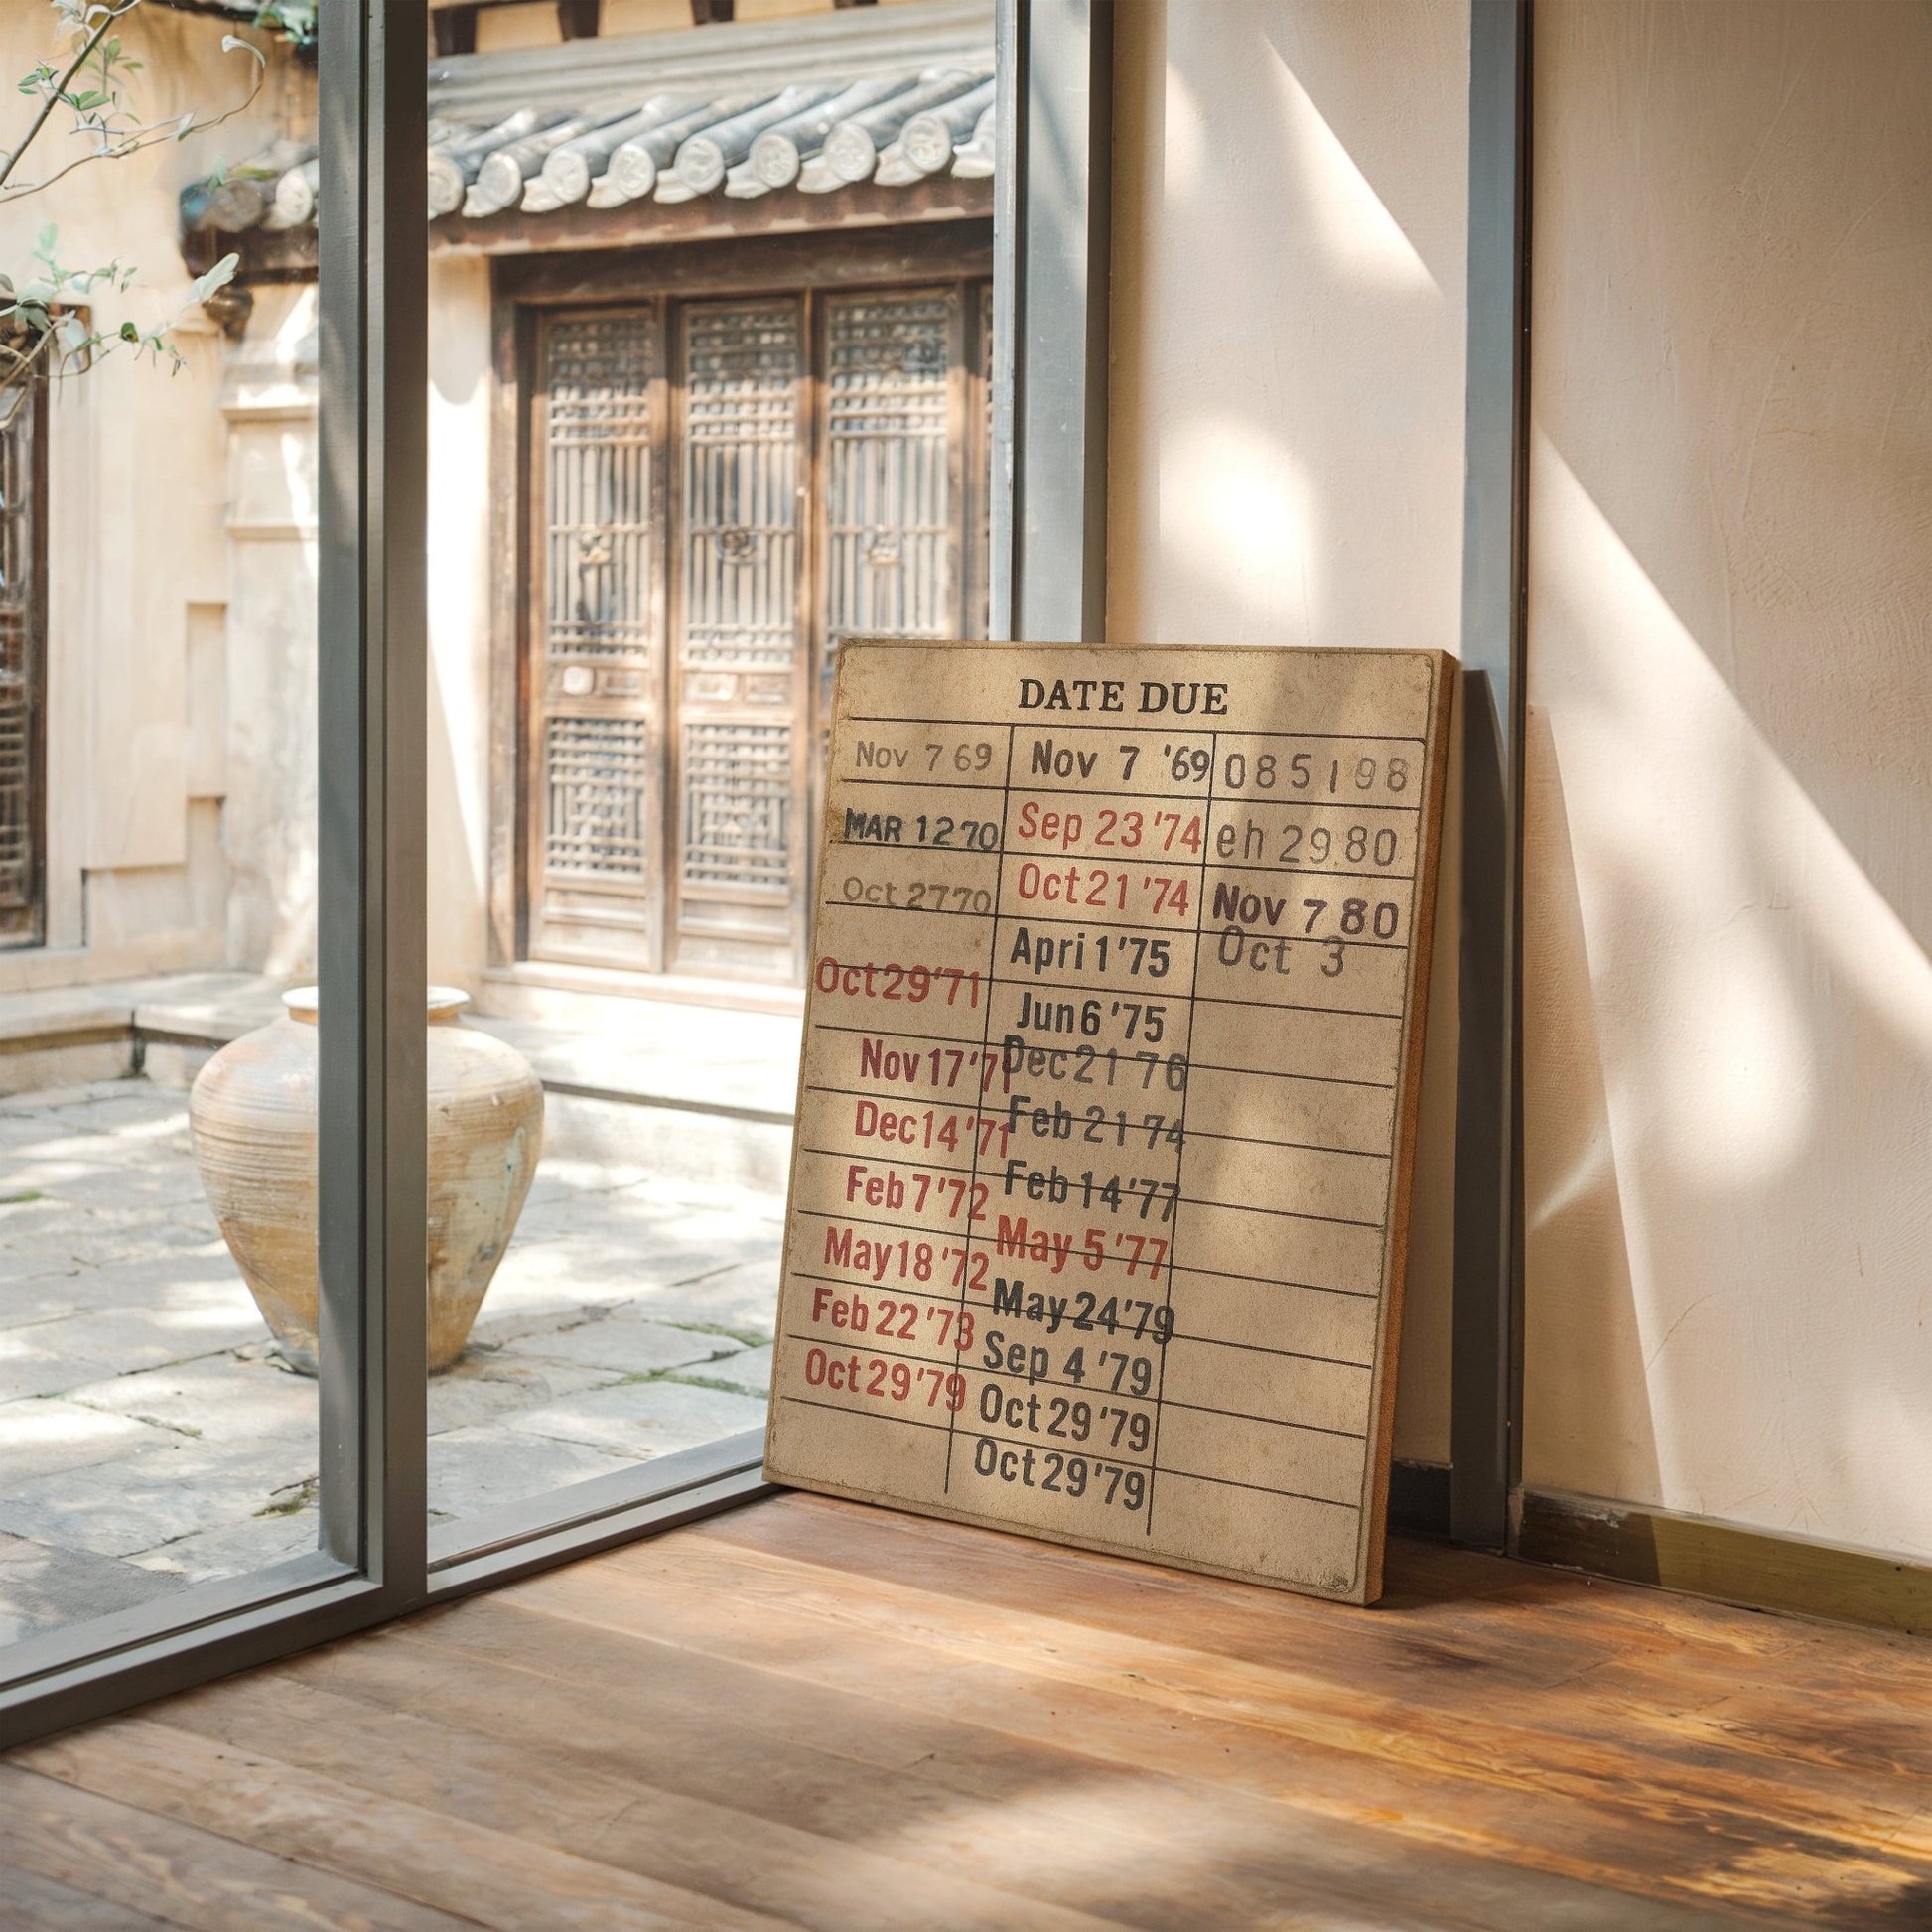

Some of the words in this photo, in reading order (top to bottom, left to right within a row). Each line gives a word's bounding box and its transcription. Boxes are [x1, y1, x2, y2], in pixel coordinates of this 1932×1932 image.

[1018, 678, 1125, 712] DATE
[1138, 681, 1228, 715] DUE
[856, 740, 908, 769] Nov
[925, 744, 943, 771] 7
[954, 743, 993, 771] 69
[1031, 739, 1098, 779] Nov
[1119, 745, 1140, 781] 7
[1163, 743, 1211, 782] '69
[844, 807, 902, 842] MAR
[1018, 801, 1083, 850] Sep
[1094, 809, 1144, 848] 23
[1154, 811, 1202, 854] '74
[843, 876, 897, 907] Oct
[1018, 863, 1081, 904] Oct
[1085, 869, 1128, 910] 21
[1143, 876, 1189, 917] '74
[1212, 882, 1287, 926] Nov
[1218, 924, 1292, 975] Oct
[1320, 935, 1345, 978] 3
[1016, 992, 1074, 1034] Jun
[1111, 1001, 1167, 1043] '75
[860, 1037, 921, 1083] Nov
[928, 1047, 965, 1088] 17
[1002, 1034, 1067, 1080] Dec
[855, 1100, 917, 1145] Dec
[1008, 1095, 1072, 1140] Feb
[1083, 1105, 1126, 1146] 21
[846, 1165, 905, 1210] Feb
[912, 1173, 932, 1213] 7
[1004, 1159, 1068, 1204] Feb
[824, 1225, 893, 1282] May
[996, 1214, 1073, 1274] May
[1083, 1228, 1106, 1271] 5
[1115, 1232, 1169, 1280] '77
[811, 1287, 869, 1332] Feb
[875, 1299, 919, 1341] 22
[993, 1277, 1068, 1334] May
[805, 1348, 861, 1393] Oct
[982, 1330, 1049, 1386] Sep
[1063, 1347, 1086, 1383] 4
[1098, 1350, 1152, 1396] '79
[979, 1383, 1041, 1433] Oct
[1047, 1397, 1091, 1441] 29
[1099, 1406, 1151, 1452] '79
[974, 1437, 1036, 1487] Oct
[1042, 1452, 1088, 1498] 29
[1094, 1462, 1145, 1511] '79
